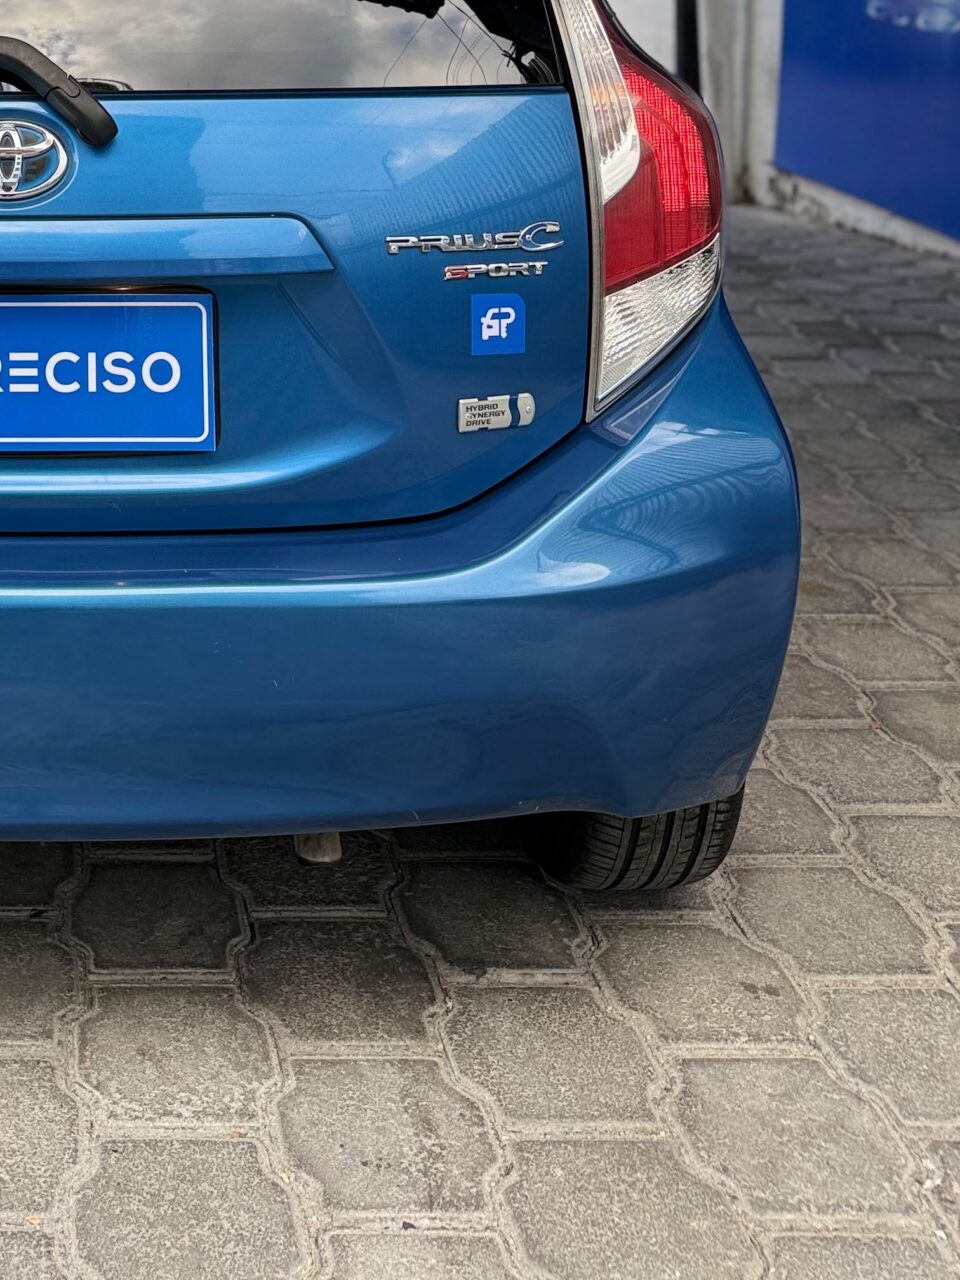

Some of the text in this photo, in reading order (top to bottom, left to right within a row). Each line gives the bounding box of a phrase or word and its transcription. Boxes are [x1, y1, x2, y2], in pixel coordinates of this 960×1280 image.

[443, 261, 549, 281] SPORT
[465, 403, 499, 412] HYBRID
[465, 418, 492, 426] DRIVE
